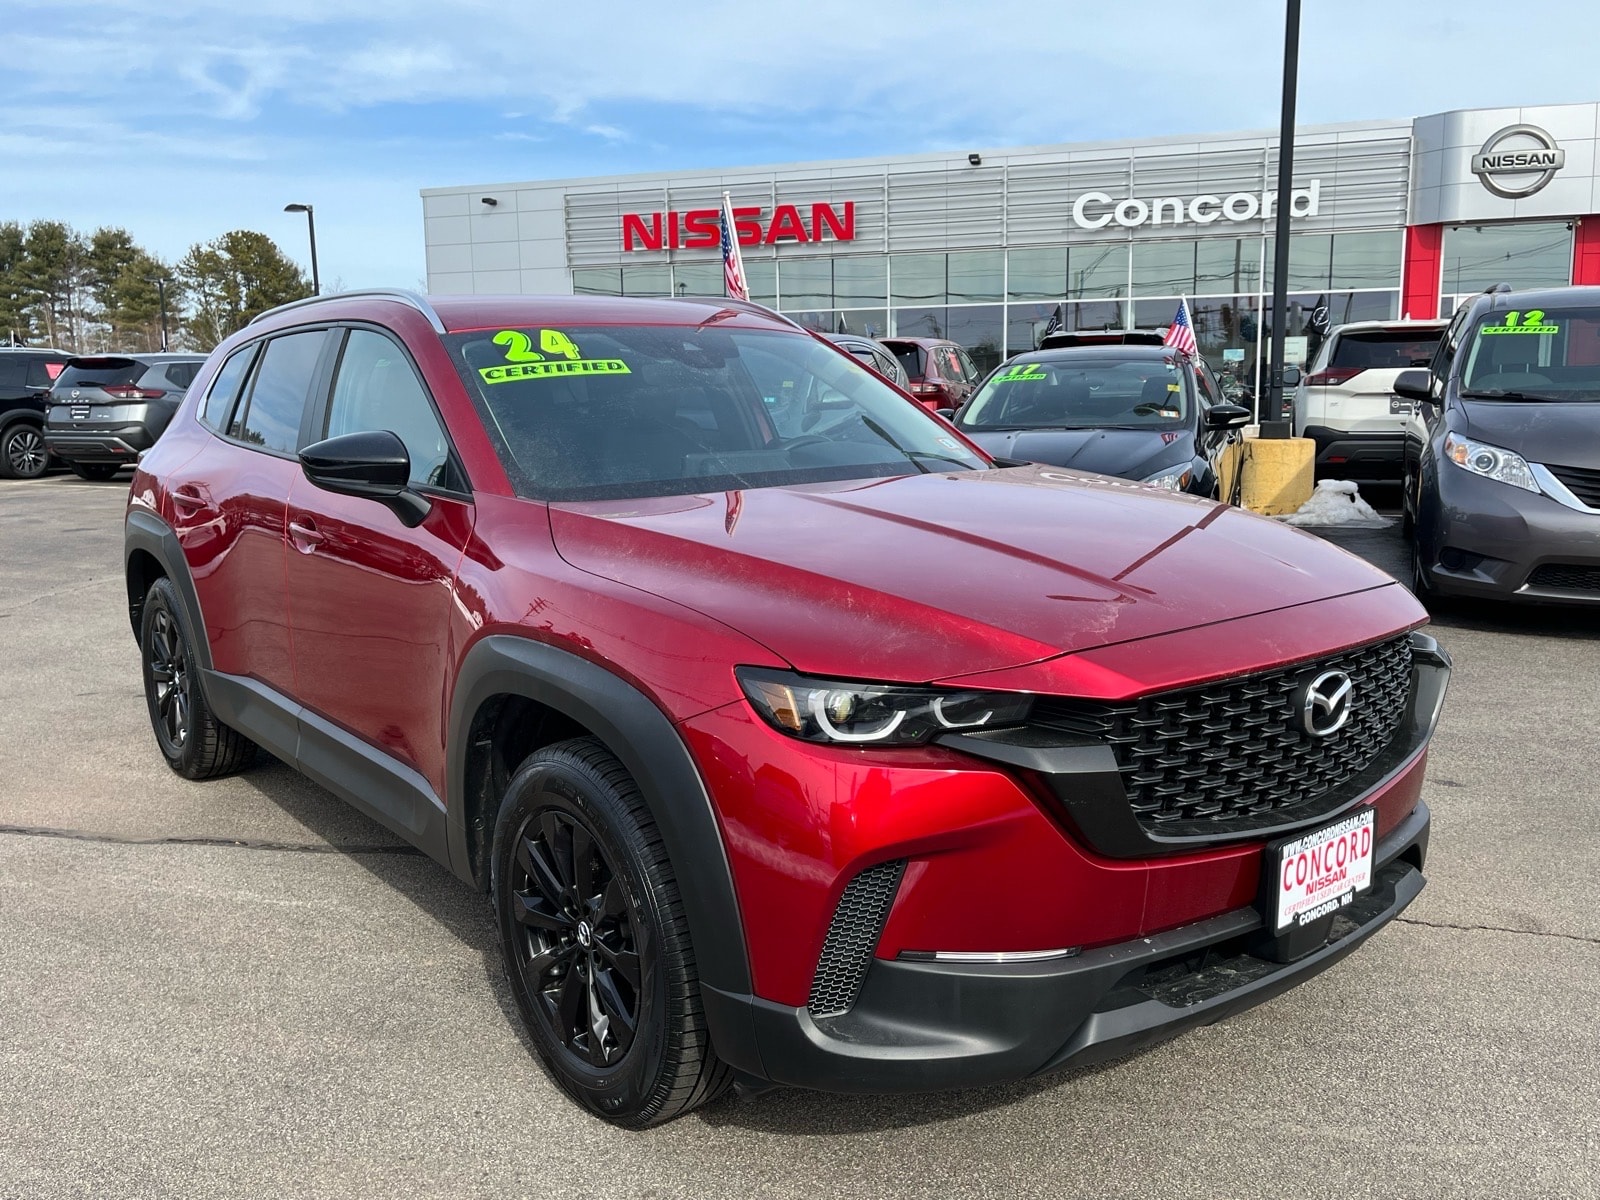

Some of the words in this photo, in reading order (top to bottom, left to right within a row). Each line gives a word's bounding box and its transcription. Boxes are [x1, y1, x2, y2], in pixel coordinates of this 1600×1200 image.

[1482, 153, 1556, 168] NISSAN
[1072, 179, 1321, 229] Concord
[623, 200, 856, 251] NISSAN
[1504, 310, 1545, 326] 12
[492, 329, 581, 362] 24
[485, 361, 625, 380] CERTIFIED
[1009, 363, 1041, 376] 17
[1283, 809, 1374, 859] WWW.CONCORDNISSAN.COM
[1283, 826, 1370, 891] CONCORD
[1284, 895, 1316, 916] CERTIFIED
[1316, 889, 1331, 902] USED
[1332, 884, 1343, 895] CAR
[1343, 872, 1366, 890] CENTER
[1306, 866, 1347, 896] NISSAN
[1341, 891, 1353, 906] NH
